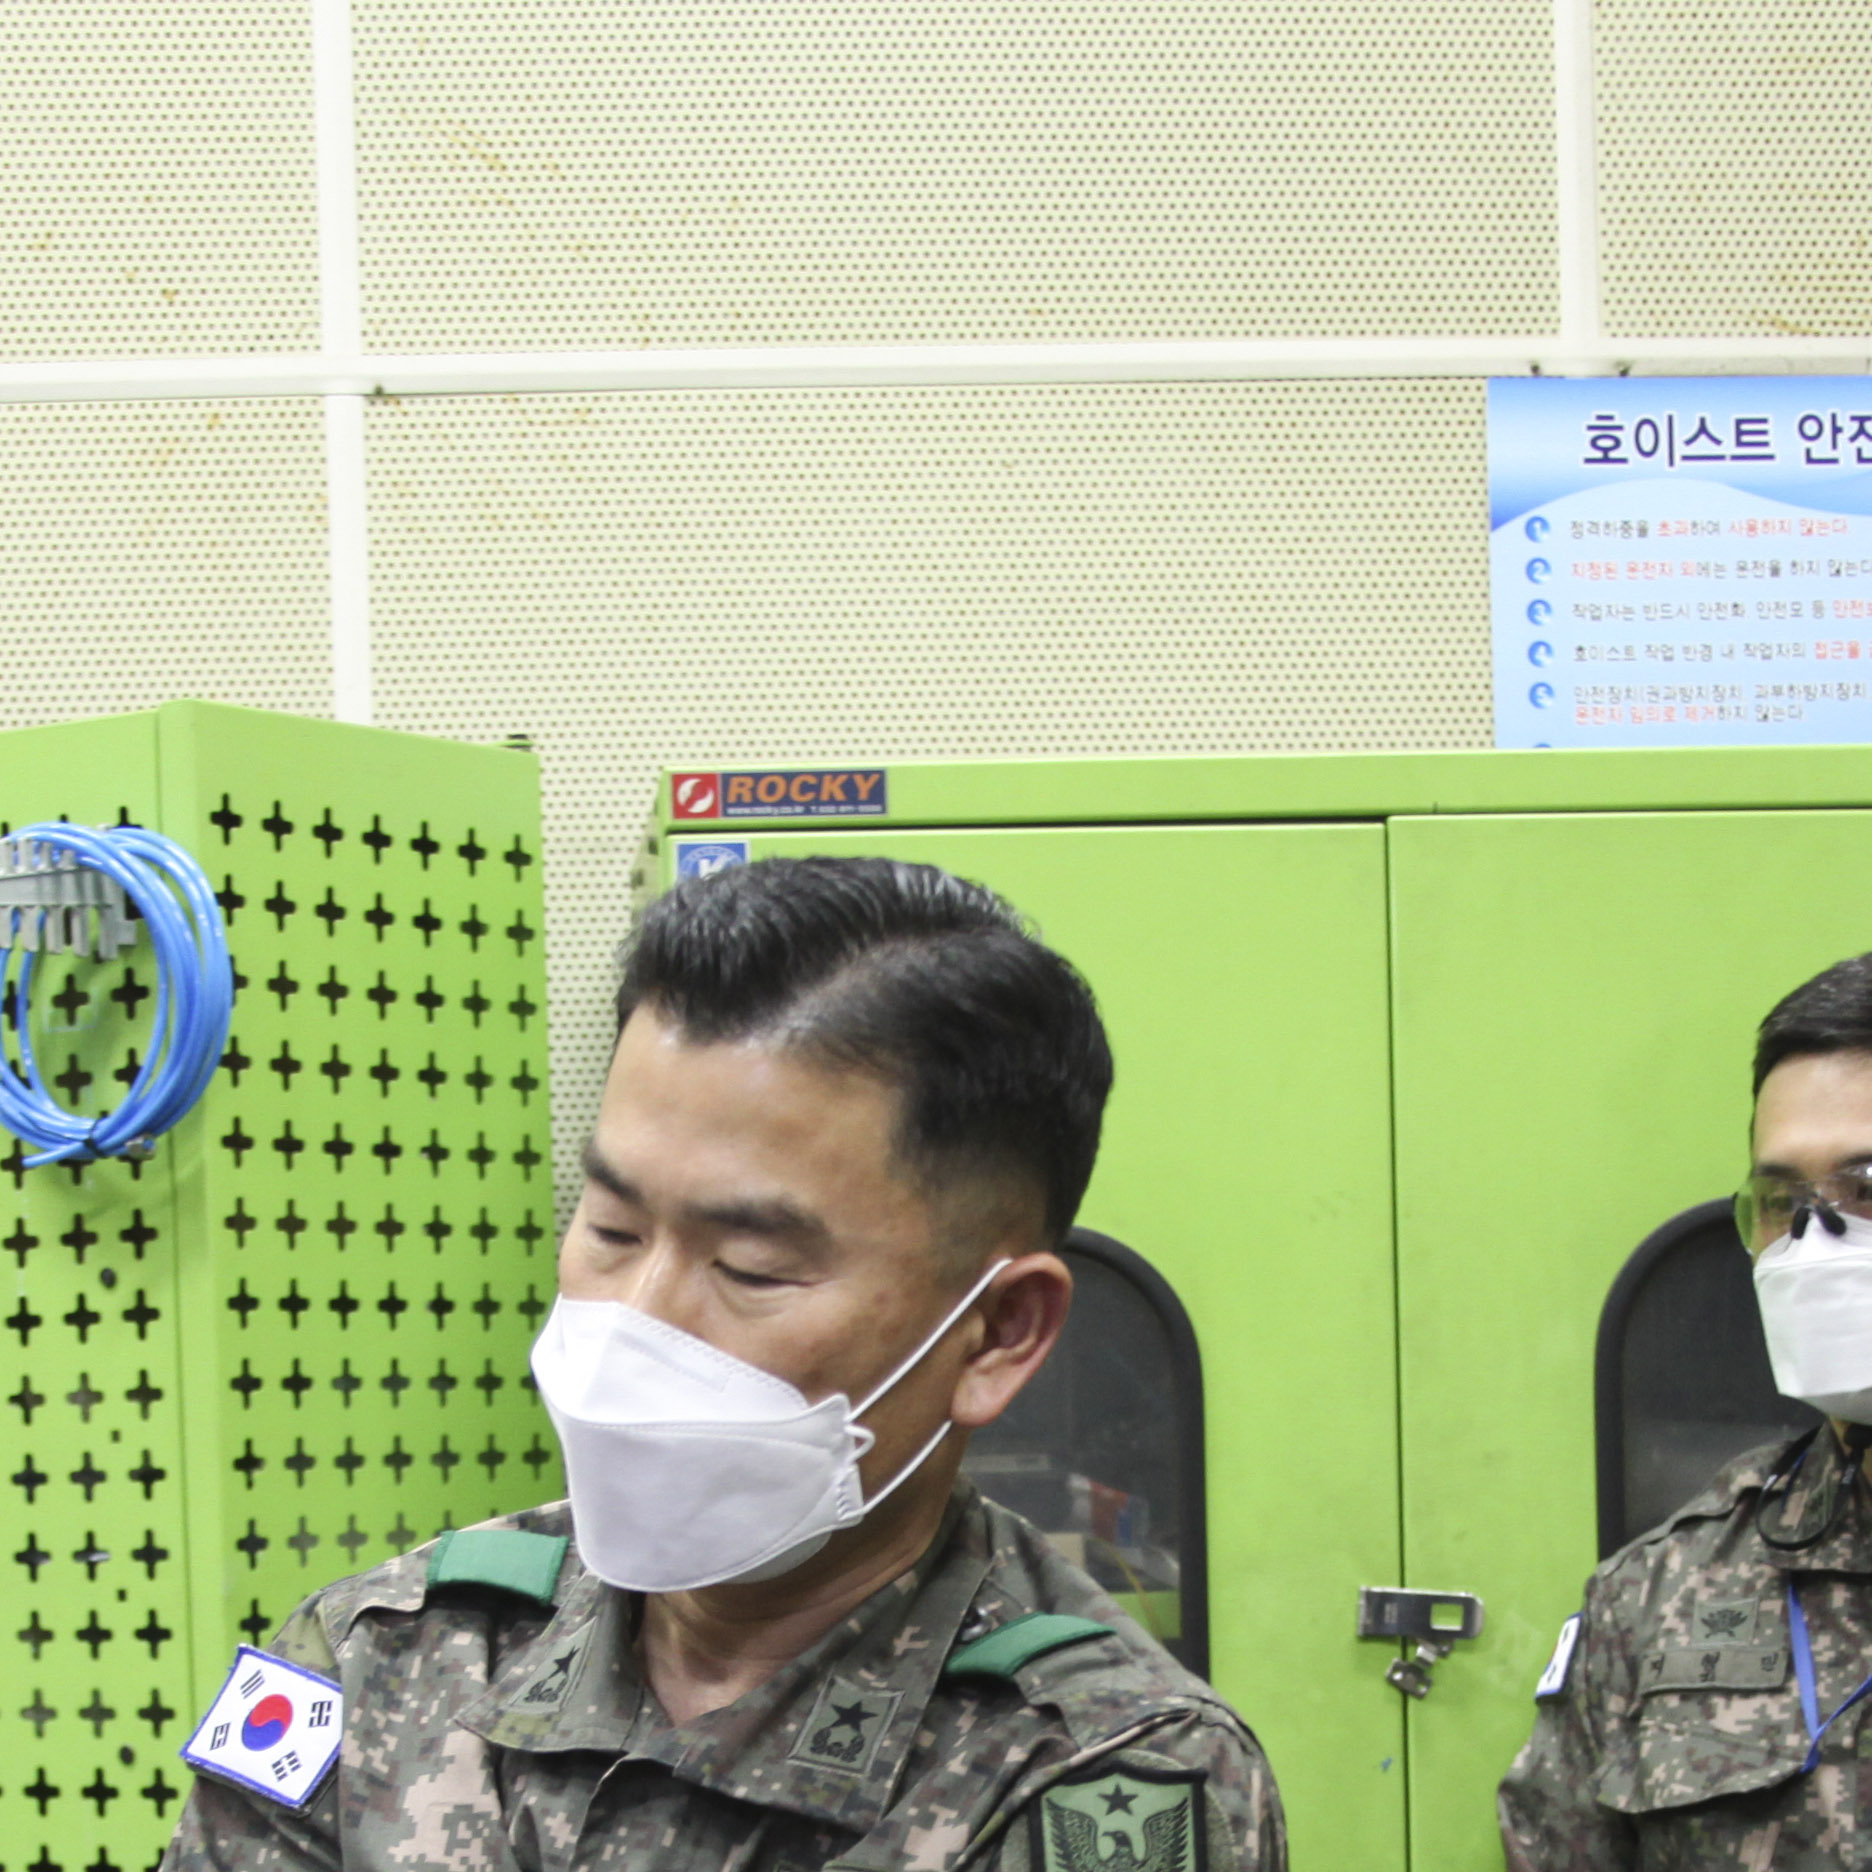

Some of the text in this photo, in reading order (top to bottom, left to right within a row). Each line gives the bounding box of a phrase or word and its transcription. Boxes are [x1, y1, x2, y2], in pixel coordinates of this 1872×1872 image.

[1583, 413, 1776, 467] 호이스트
[1571, 518, 1792, 539] 정격하중을 초과하여 사용하지
[1626, 561, 1674, 580] 운전자
[1736, 559, 1782, 578] 운전을
[1790, 559, 1821, 576] 하지
[1573, 603, 1636, 621] 작업자는
[1642, 602, 1690, 620] 반드시
[1574, 645, 1637, 662] 호이스트
[1645, 644, 1674, 662] 작업
[727, 773, 881, 803] ROCKY
